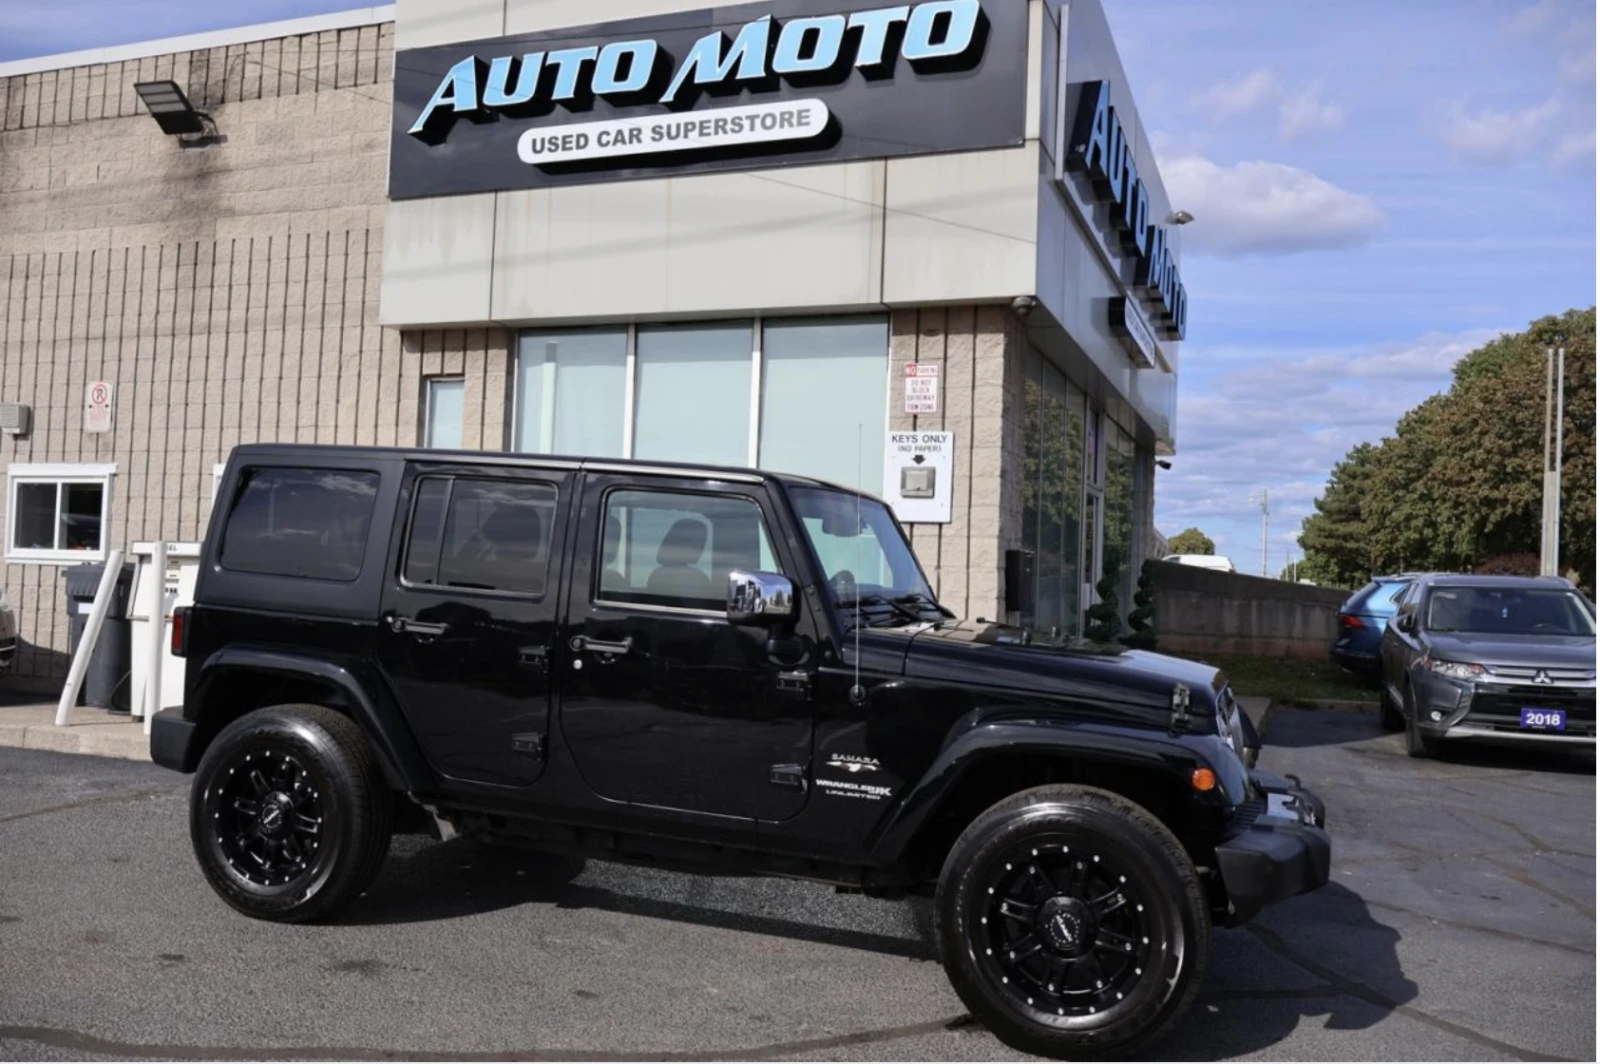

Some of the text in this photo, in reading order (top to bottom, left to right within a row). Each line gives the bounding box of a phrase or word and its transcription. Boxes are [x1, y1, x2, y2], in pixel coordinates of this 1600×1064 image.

[407, 0, 981, 134] AUTO MOTO
[531, 107, 812, 156] USED CAR SUPERSTORE
[1085, 79, 1149, 257] AUTO
[1148, 224, 1188, 340] MOTO
[891, 434, 948, 444] KEYS ONLY
[1526, 713, 1561, 726] 2018
[831, 753, 880, 765] SAHARA
[825, 789, 881, 800] UNLIMITED
